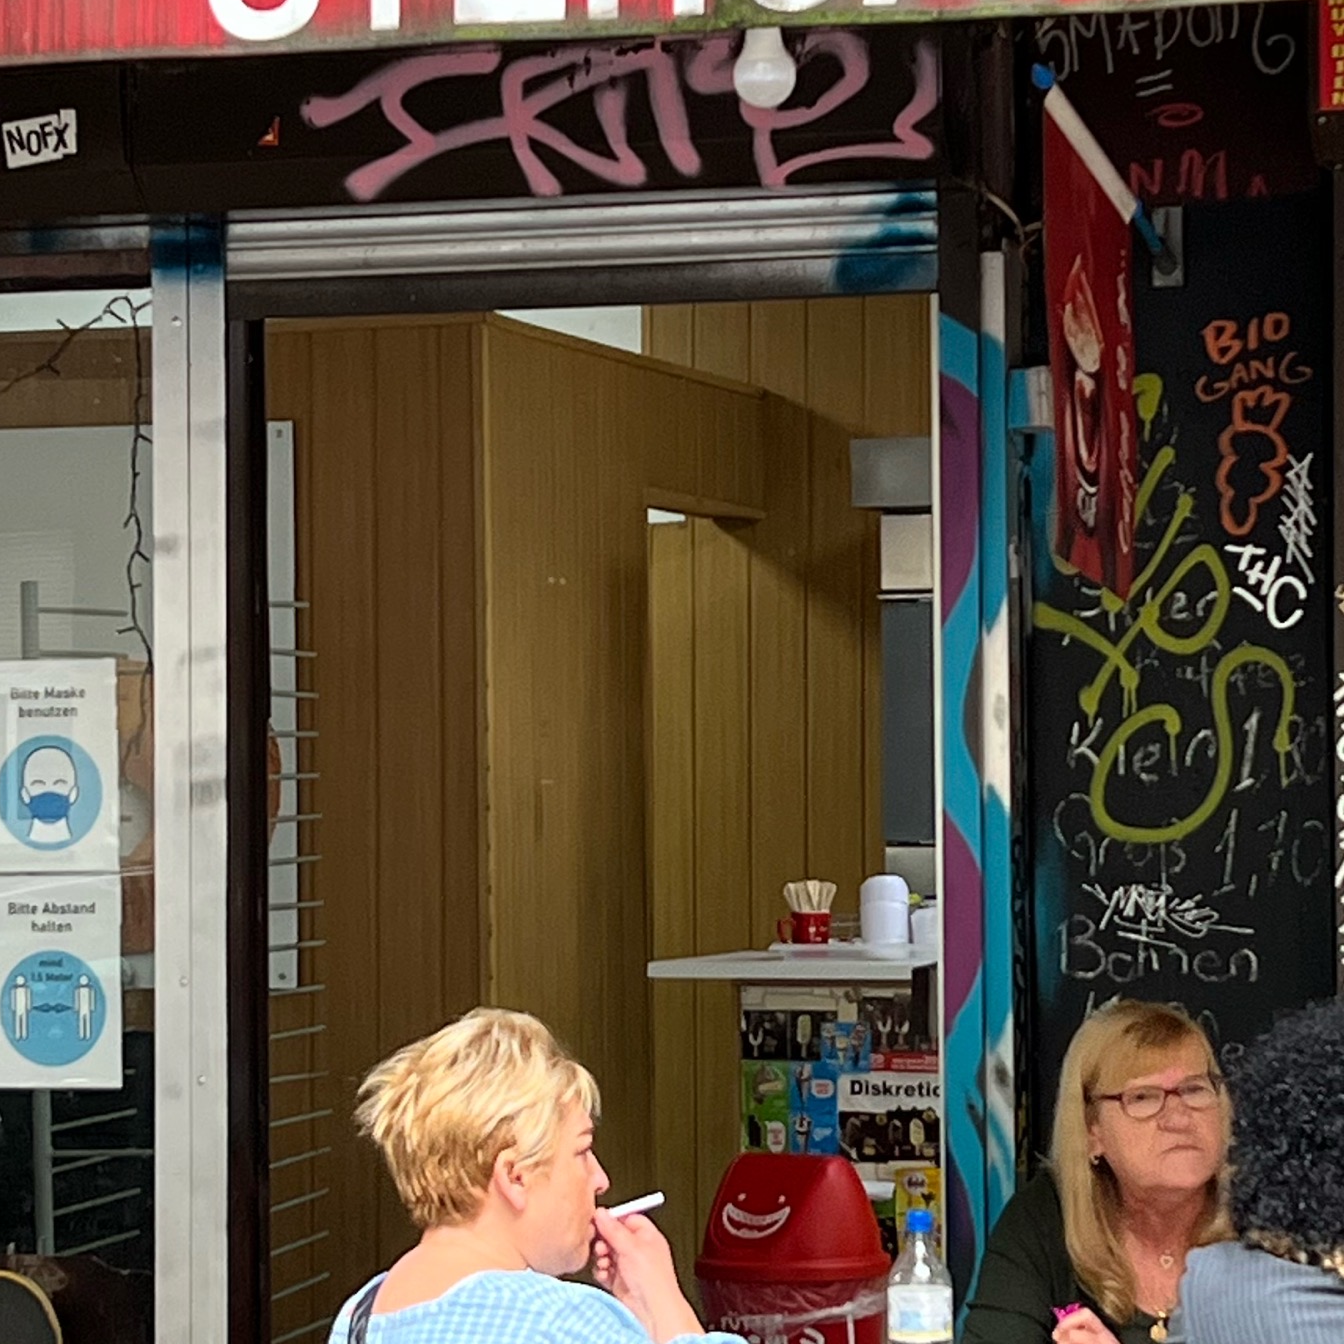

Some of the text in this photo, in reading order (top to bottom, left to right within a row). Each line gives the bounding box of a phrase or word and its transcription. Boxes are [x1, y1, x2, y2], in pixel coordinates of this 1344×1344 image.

[6, 121, 69, 156] NOFX
[1202, 312, 1291, 365] BIO
[1195, 351, 1314, 404] GANG
[1224, 543, 1307, 630] THC
[44, 686, 86, 700] Maske
[18, 706, 78, 719] benutzen
[8, 902, 96, 915] Bitte Abstand
[31, 920, 73, 933] halten
